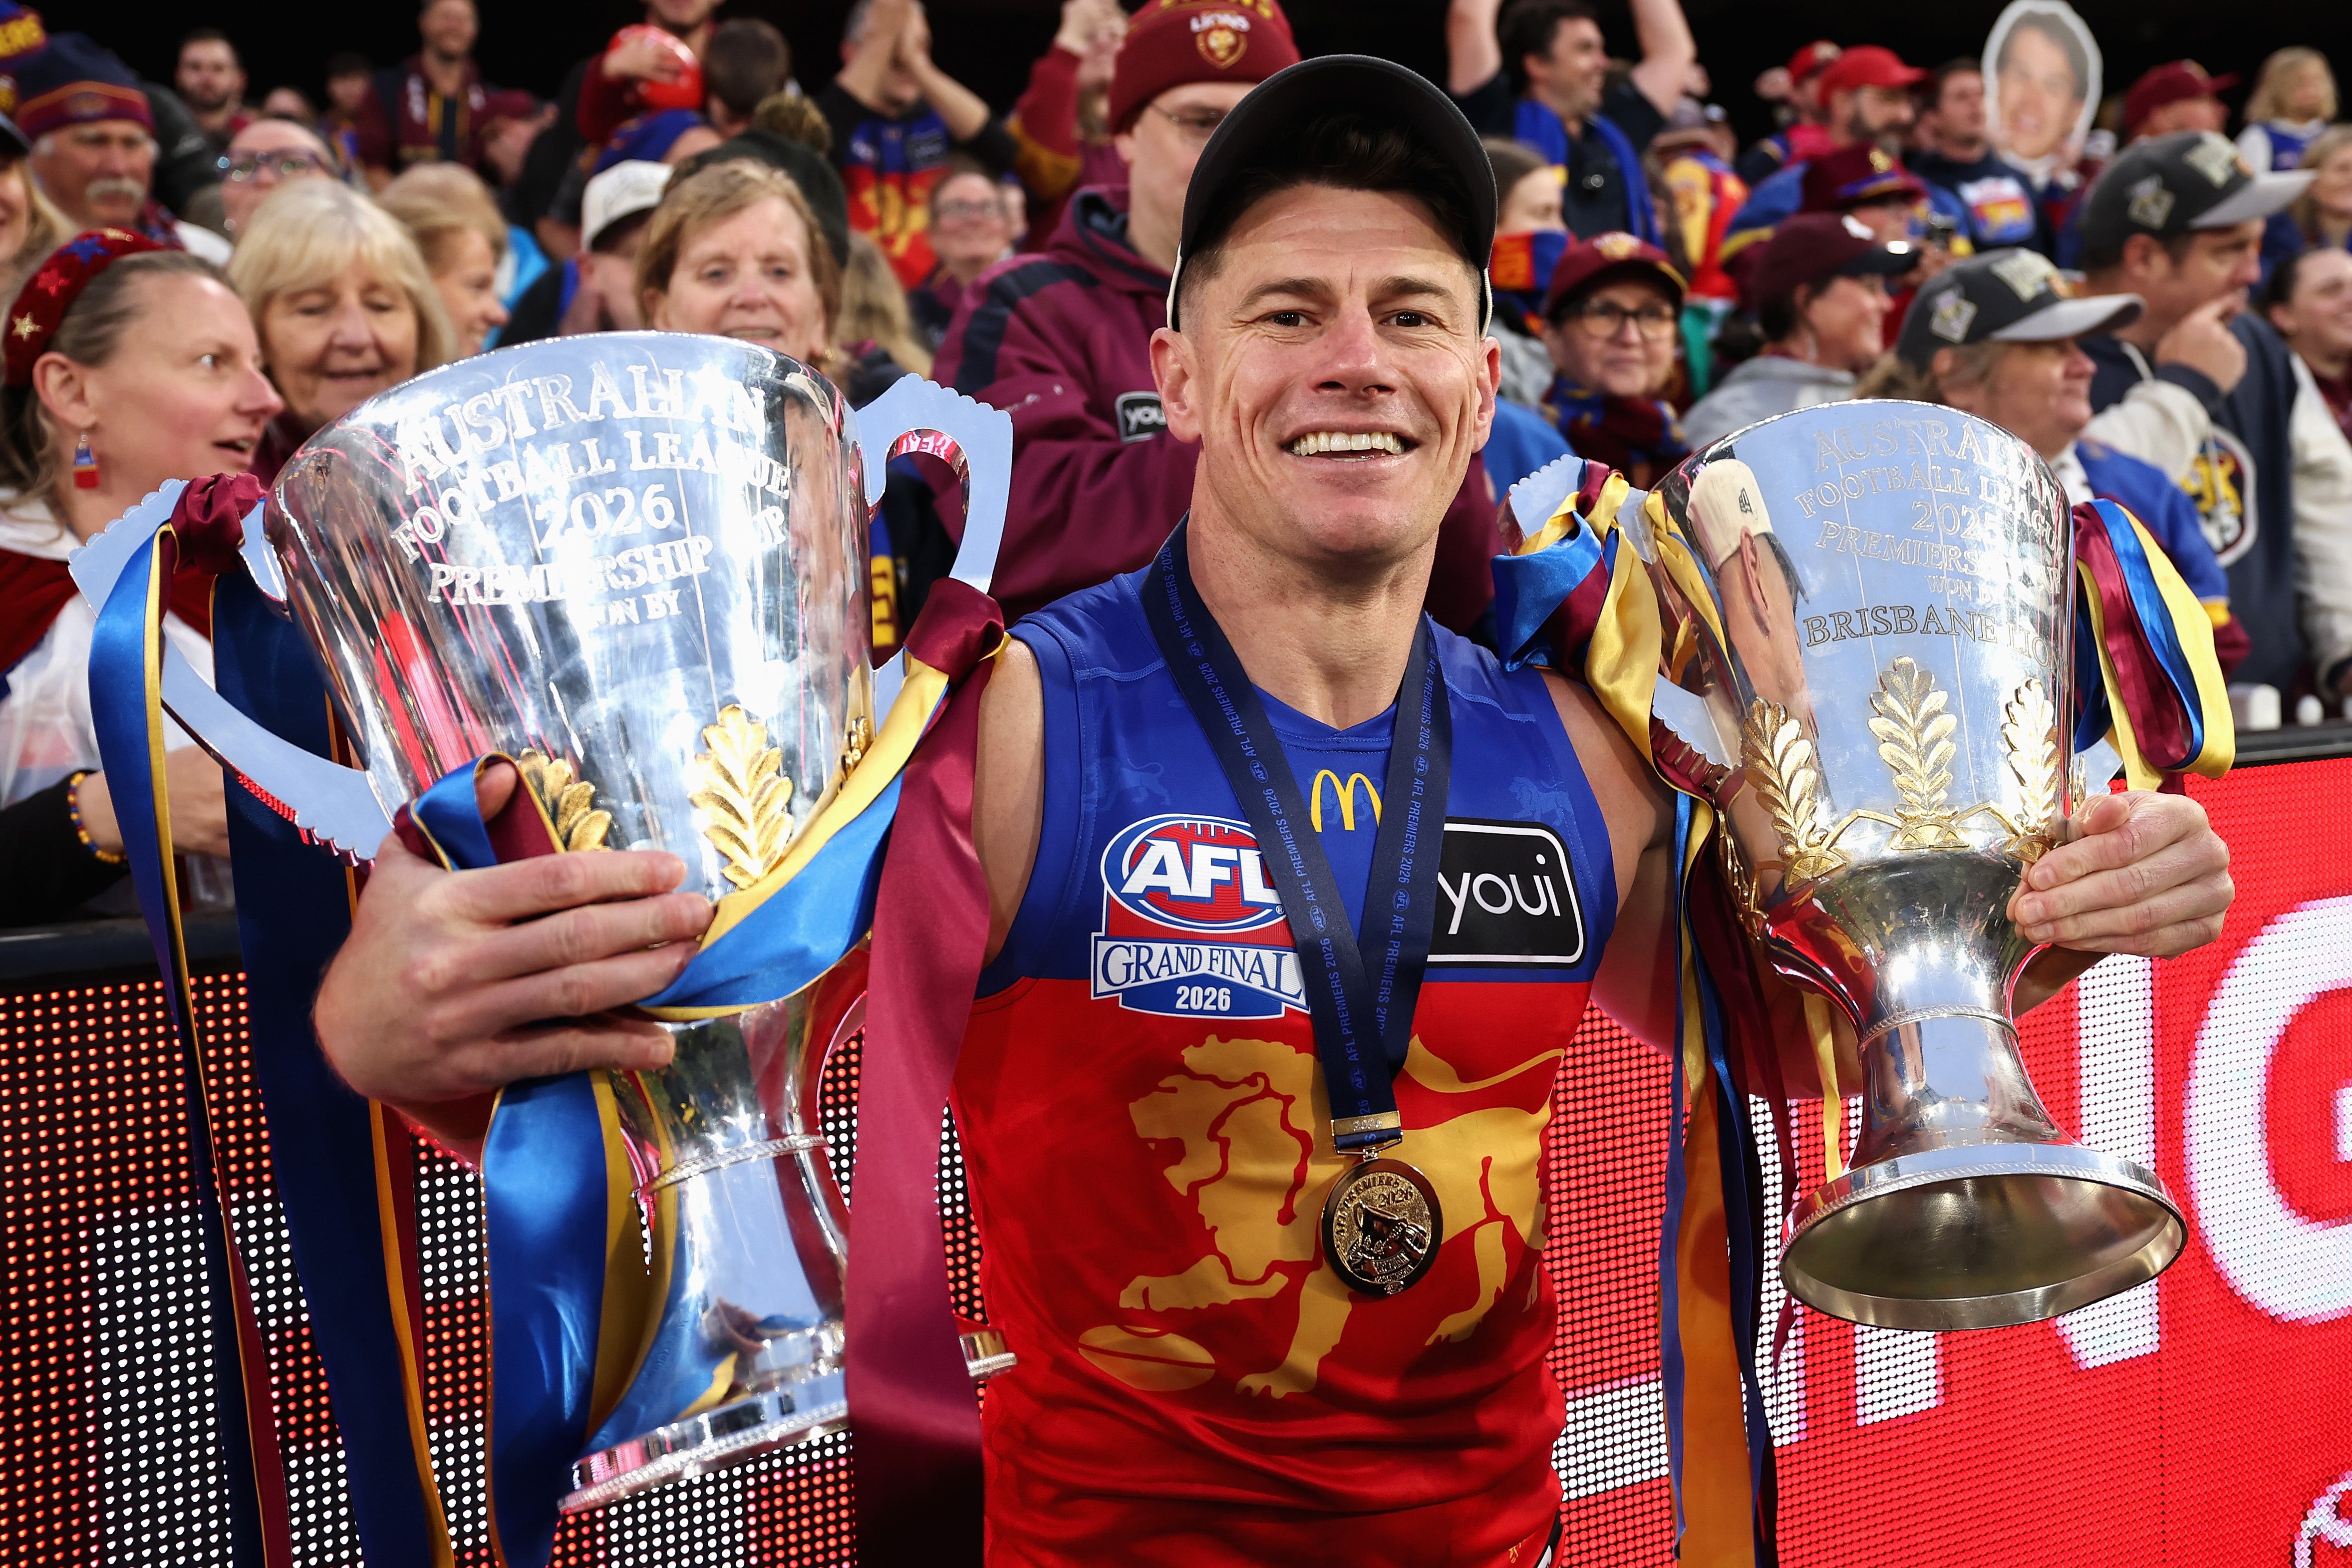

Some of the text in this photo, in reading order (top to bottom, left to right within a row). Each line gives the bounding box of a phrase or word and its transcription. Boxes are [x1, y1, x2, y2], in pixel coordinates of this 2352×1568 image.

[396, 360, 766, 496] AUSTRALIAN
[1124, 405, 1167, 434] you
[391, 427, 791, 565] FOOTBALL LEAUE
[535, 483, 676, 551] 2026
[1794, 461, 1970, 519] FOOTBALL
[427, 505, 787, 606] PREMIRSHIP UP
[1815, 521, 2023, 582] PREMIERS
[588, 588, 682, 626] ON BY
[1160, 547, 1194, 638] AFL PREMIERS 2026
[1925, 575, 1972, 602] WON
[1803, 604, 1998, 647] BRISBANE
[1427, 657, 1437, 674] AFL
[1198, 662, 1257, 757] AFL PREMIERS 2026
[1421, 676, 1434, 725] PREMIERS
[1419, 726, 1431, 751] 2026
[1263, 788, 1317, 902] AFL PREMIERS 2026
[1398, 777, 1425, 884] AFL PREMIERS 2026
[1120, 839, 1284, 904] AFL
[1438, 854, 1561, 935] youi
[1101, 944, 1303, 1000] GRAND FINAL
[1175, 985, 1231, 1011] 2026
[1320, 937, 1359, 1062] AFL PREMIERS 2026
[1376, 914, 1405, 1037] AFL PREMIERS 20
